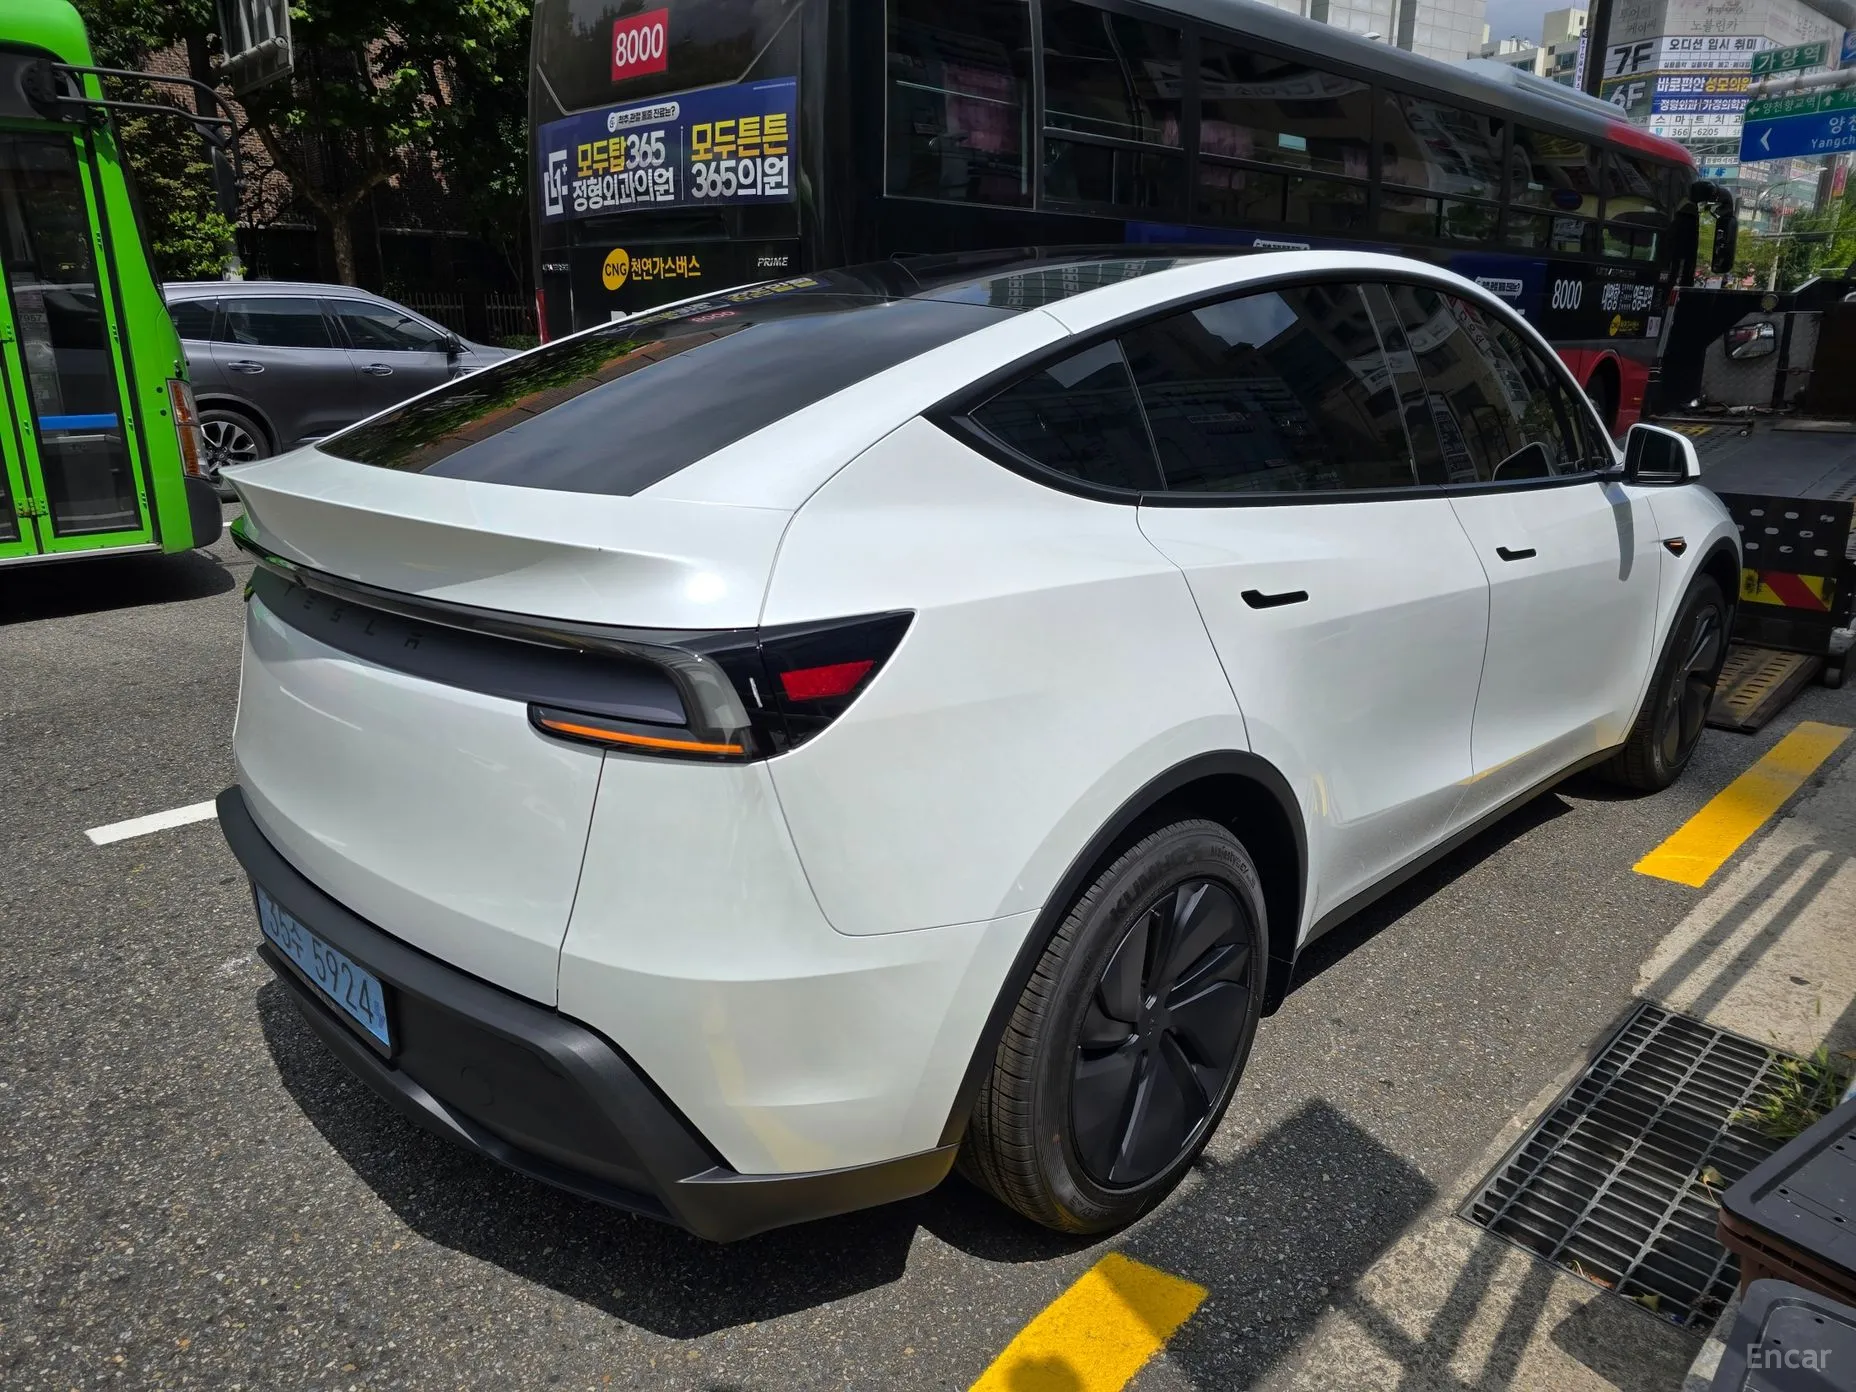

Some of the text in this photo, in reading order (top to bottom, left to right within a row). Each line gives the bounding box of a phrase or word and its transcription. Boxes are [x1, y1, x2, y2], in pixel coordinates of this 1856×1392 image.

[615, 22, 664, 67] 8000
[1613, 41, 1654, 75] 7F
[1669, 38, 1703, 50] 오디션
[1708, 38, 1730, 50] 입시
[1734, 38, 1757, 50] 취미
[1758, 44, 1821, 69] 가양역
[1609, 81, 1646, 110] 6F
[1660, 99, 1697, 111] 정형외과
[1763, 95, 1816, 114] 양천향교역
[691, 113, 789, 162] 모두튼튼
[577, 130, 665, 178] 모두탑365
[572, 165, 675, 212] 정형외과의원
[691, 155, 789, 198] 365의원
[605, 255, 701, 281] CNG 천연가스버스
[757, 256, 789, 268] PRIME
[1552, 279, 1583, 310] 8000
[311, 936, 374, 1024] 5924
